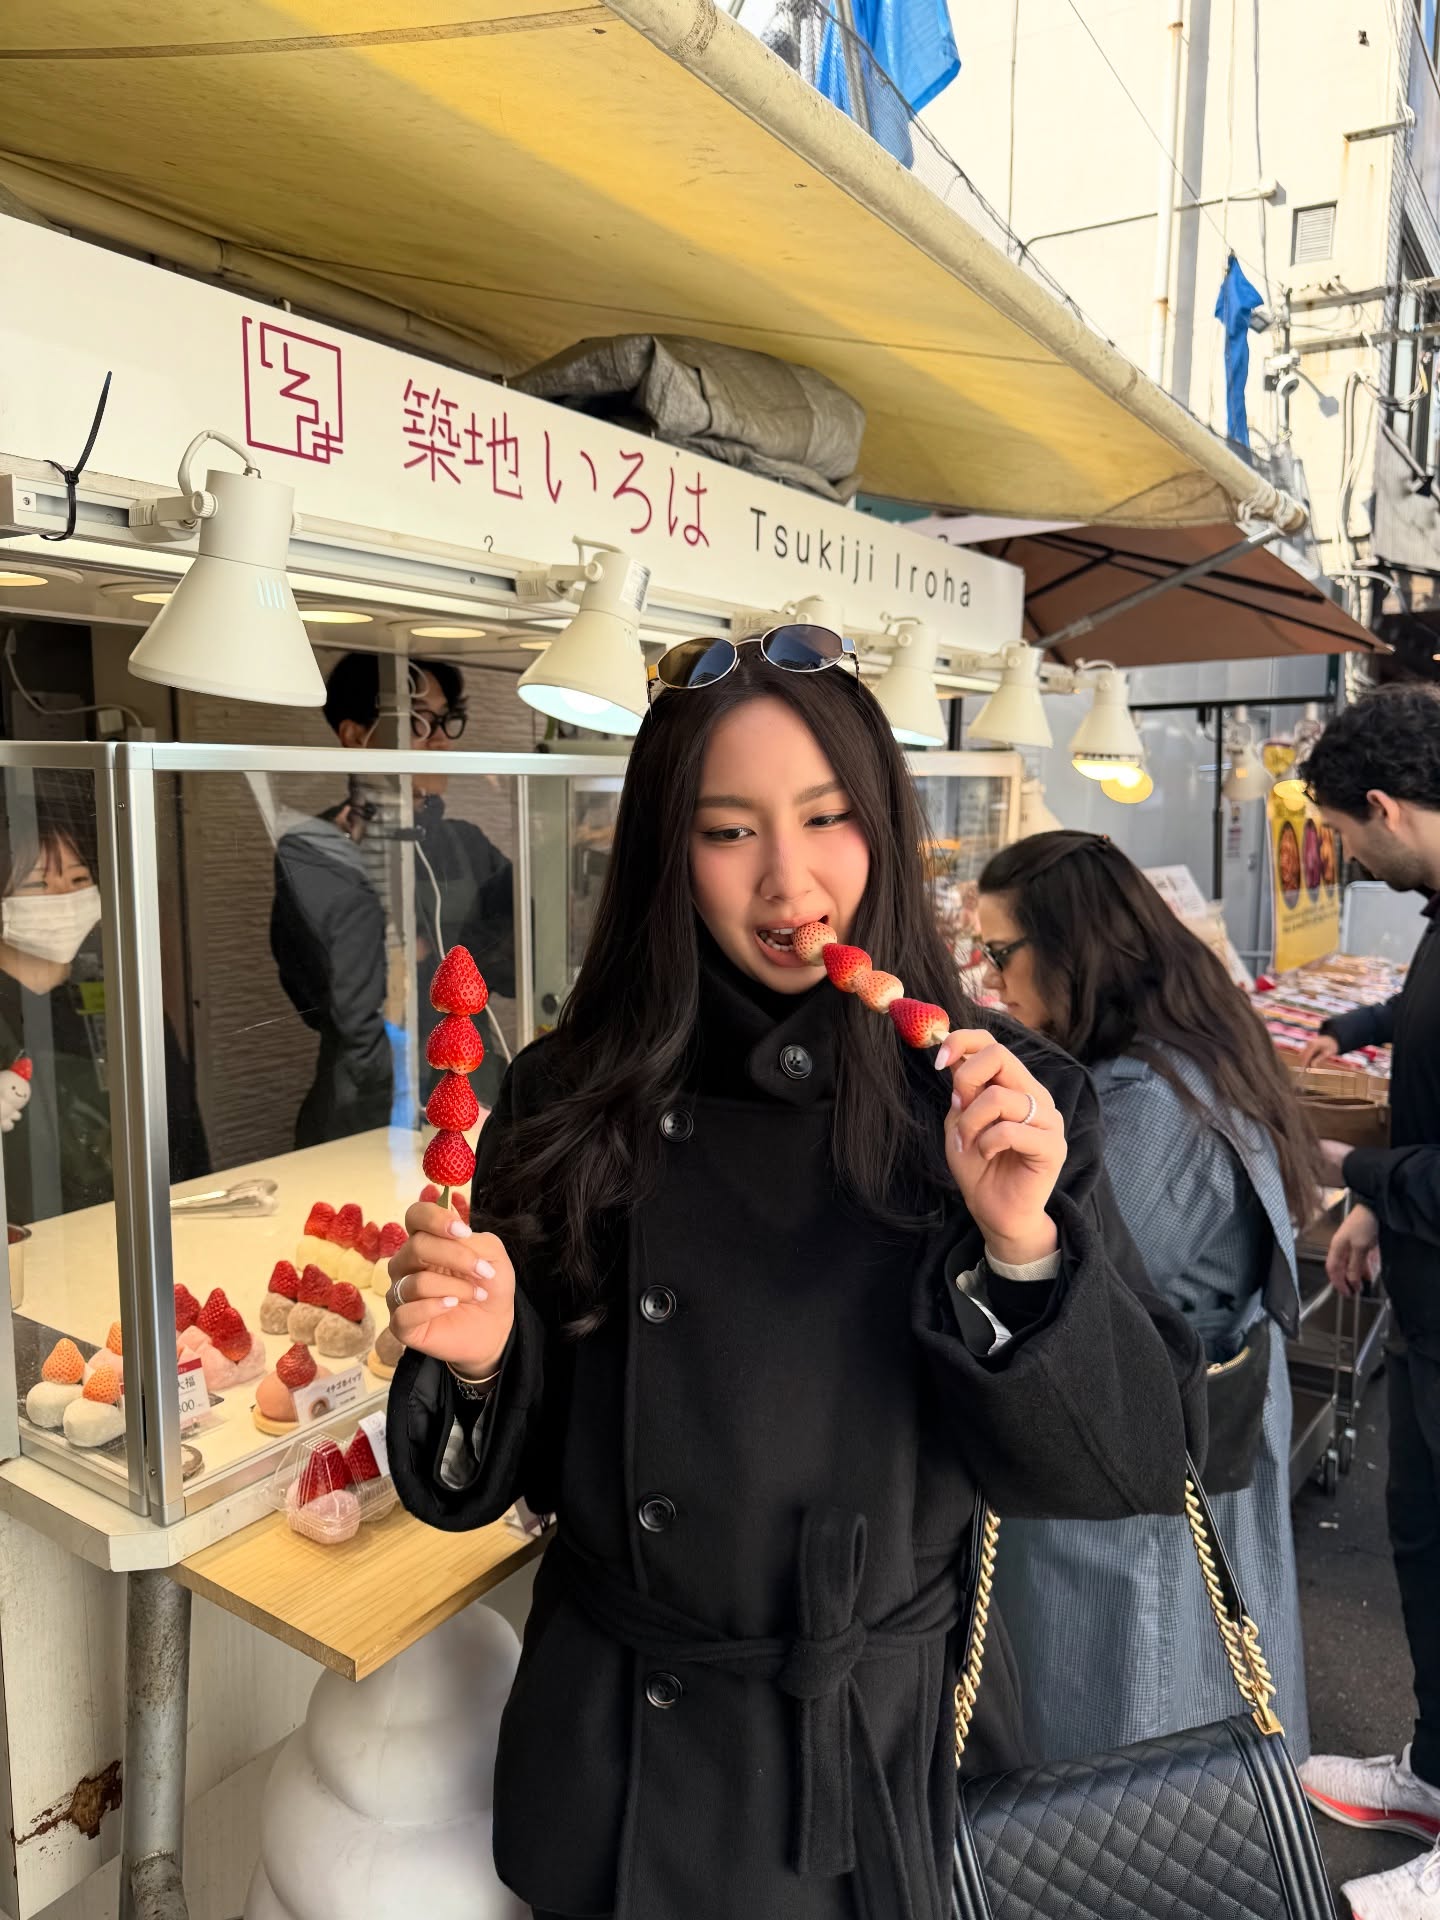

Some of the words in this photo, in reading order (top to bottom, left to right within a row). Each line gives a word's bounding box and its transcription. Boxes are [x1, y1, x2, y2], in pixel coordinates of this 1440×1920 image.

[402, 378, 710, 547] 築地いろは
[749, 507, 875, 585] Tsukiji
[895, 552, 971, 607] Iroha
